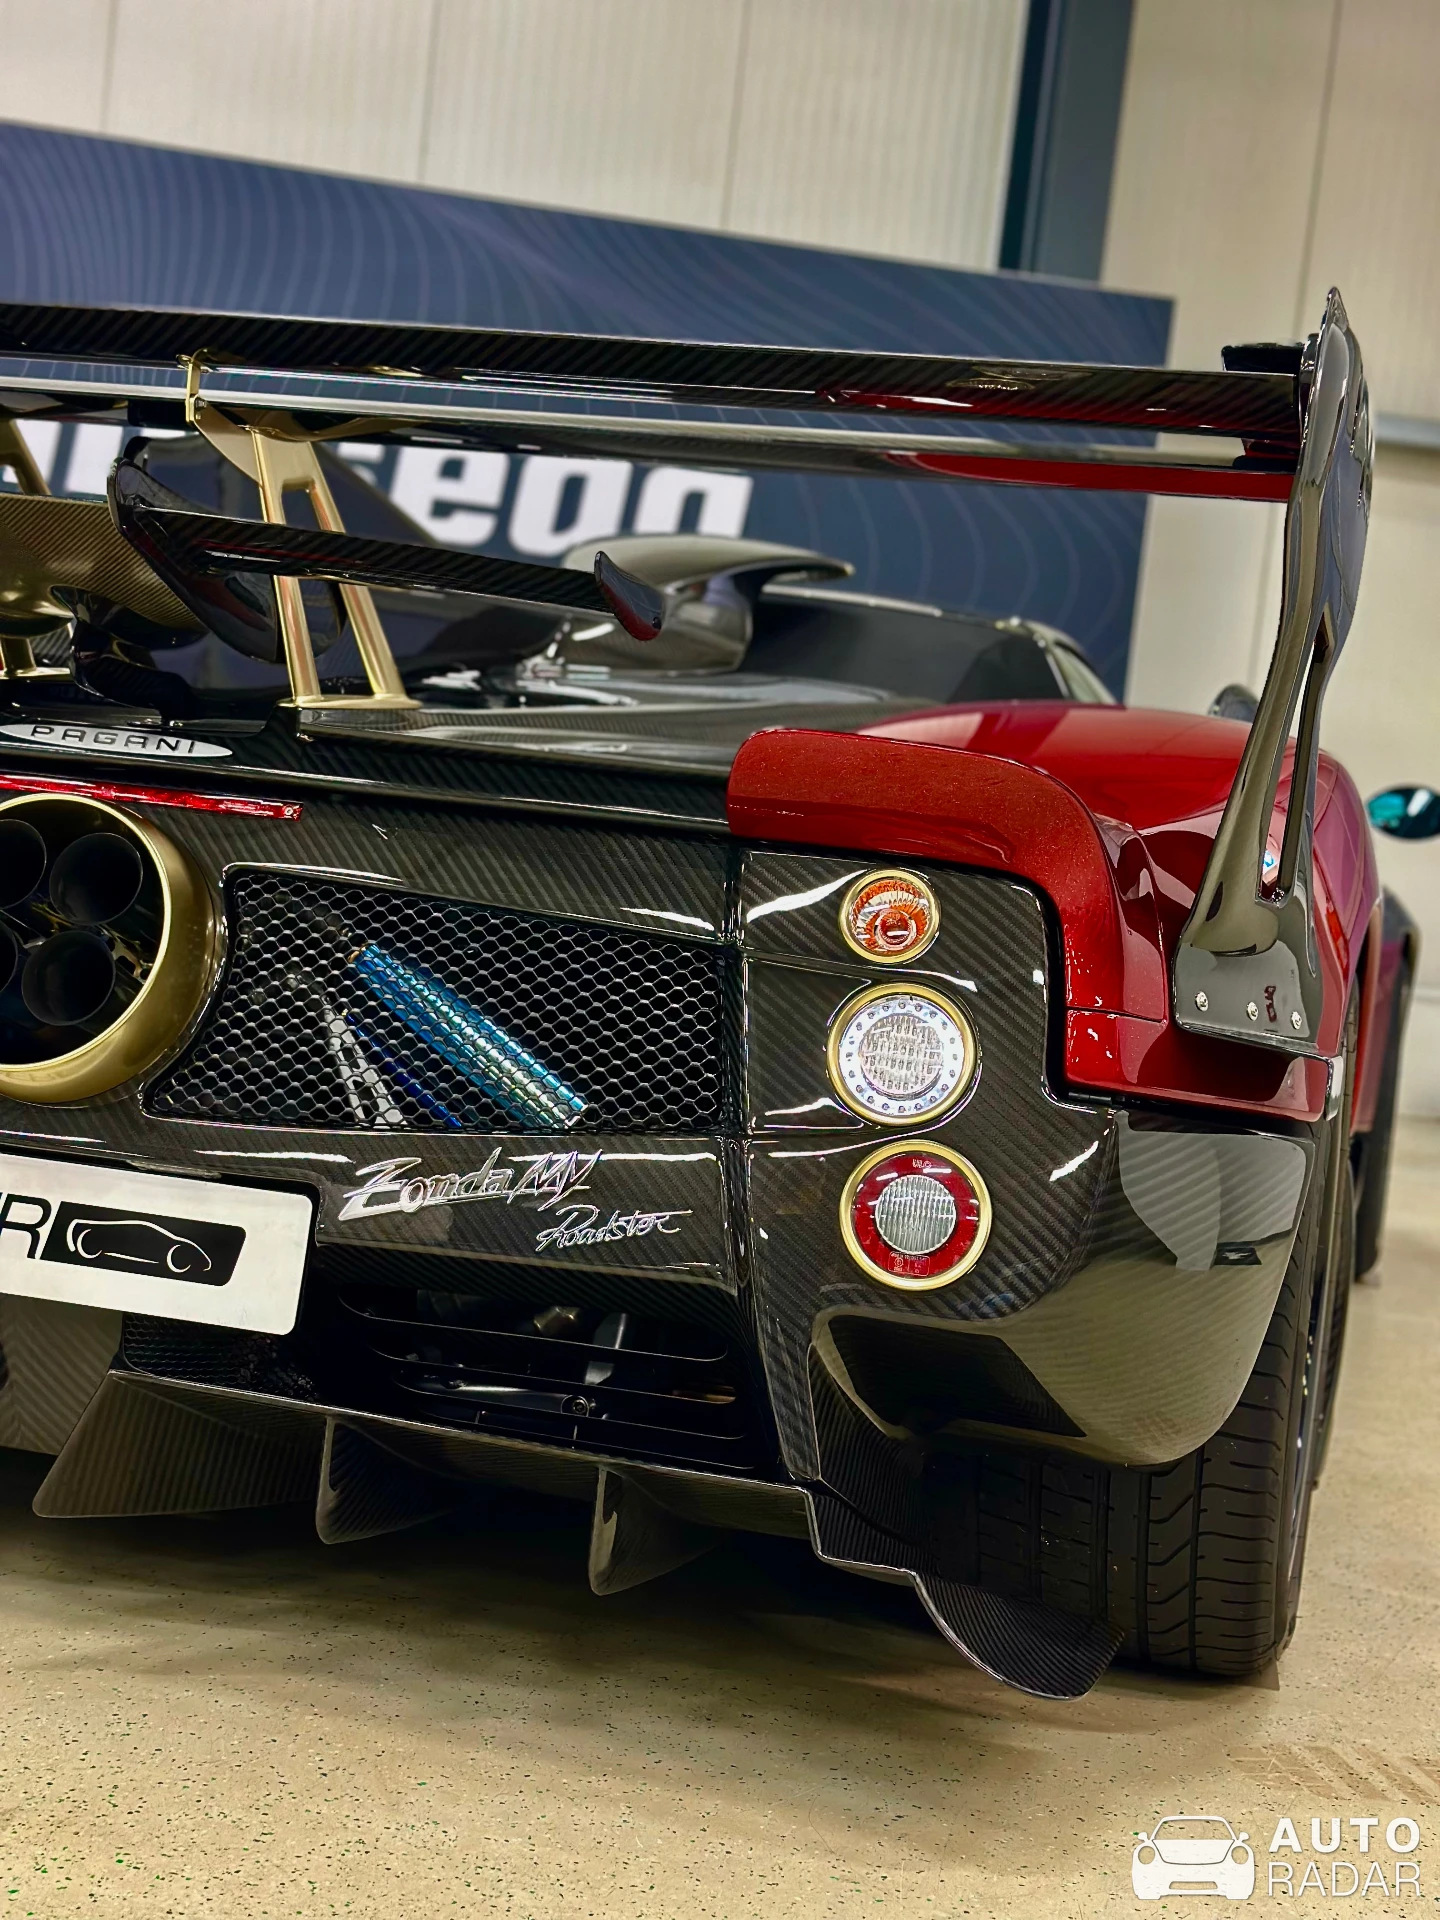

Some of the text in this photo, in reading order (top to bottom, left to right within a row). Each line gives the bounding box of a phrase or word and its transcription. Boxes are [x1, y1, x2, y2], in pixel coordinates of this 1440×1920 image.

[31, 725, 196, 754] PAGANI
[338, 1146, 514, 1222] Zonda
[535, 1204, 693, 1251] Roadster
